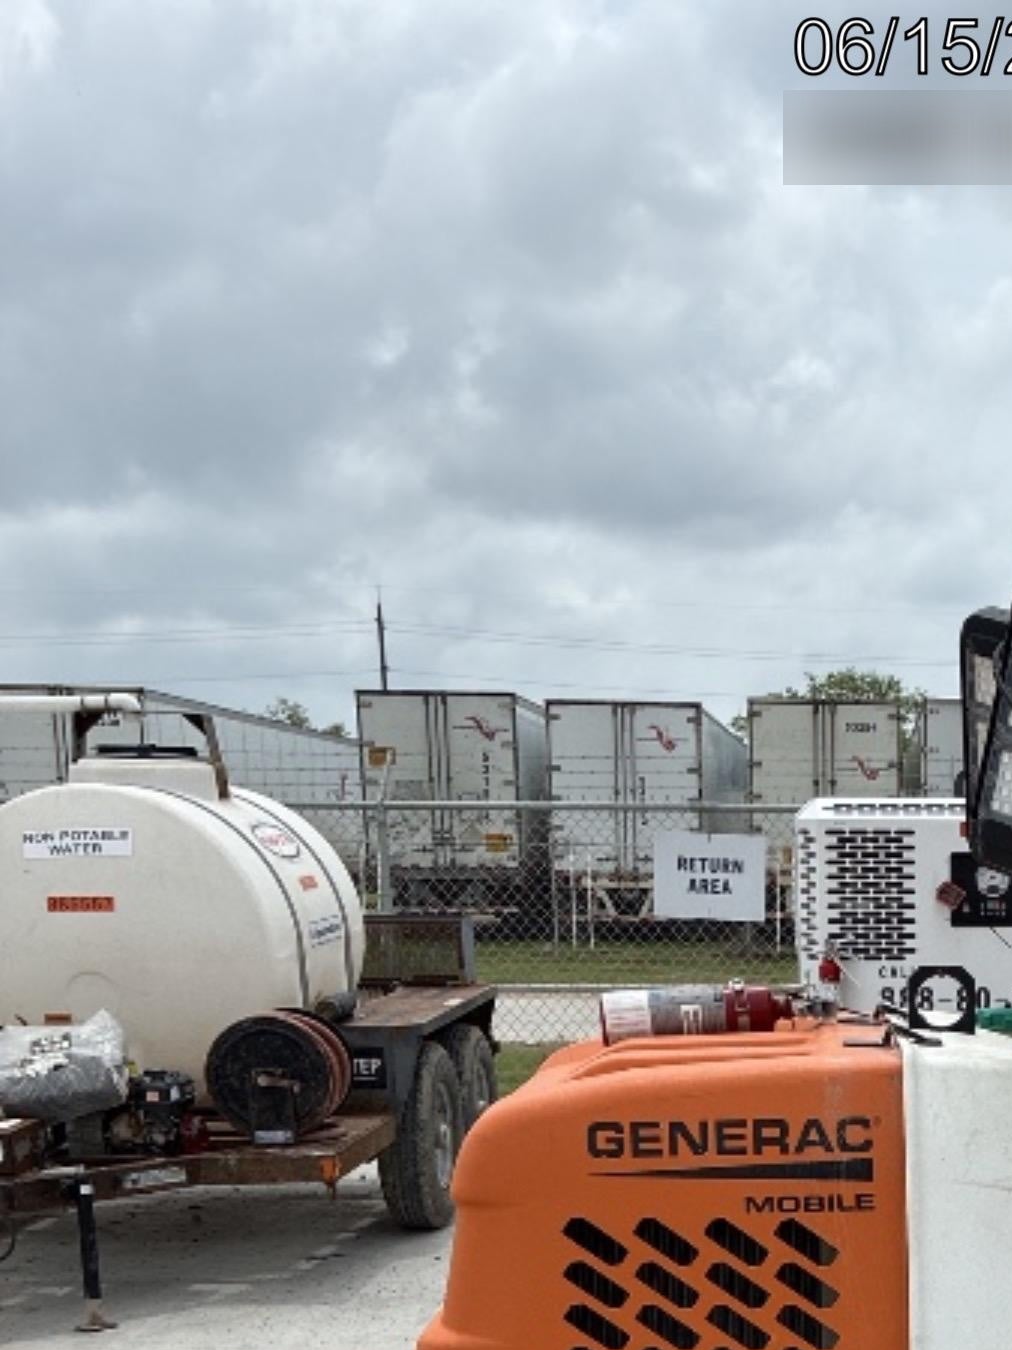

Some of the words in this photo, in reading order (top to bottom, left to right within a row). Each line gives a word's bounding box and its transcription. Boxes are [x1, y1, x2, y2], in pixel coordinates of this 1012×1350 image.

[676, 855, 745, 875] RETURN
[687, 878, 733, 895] AREA
[586, 1115, 874, 1160] GENERAC
[744, 1192, 877, 1215] MOBILE
